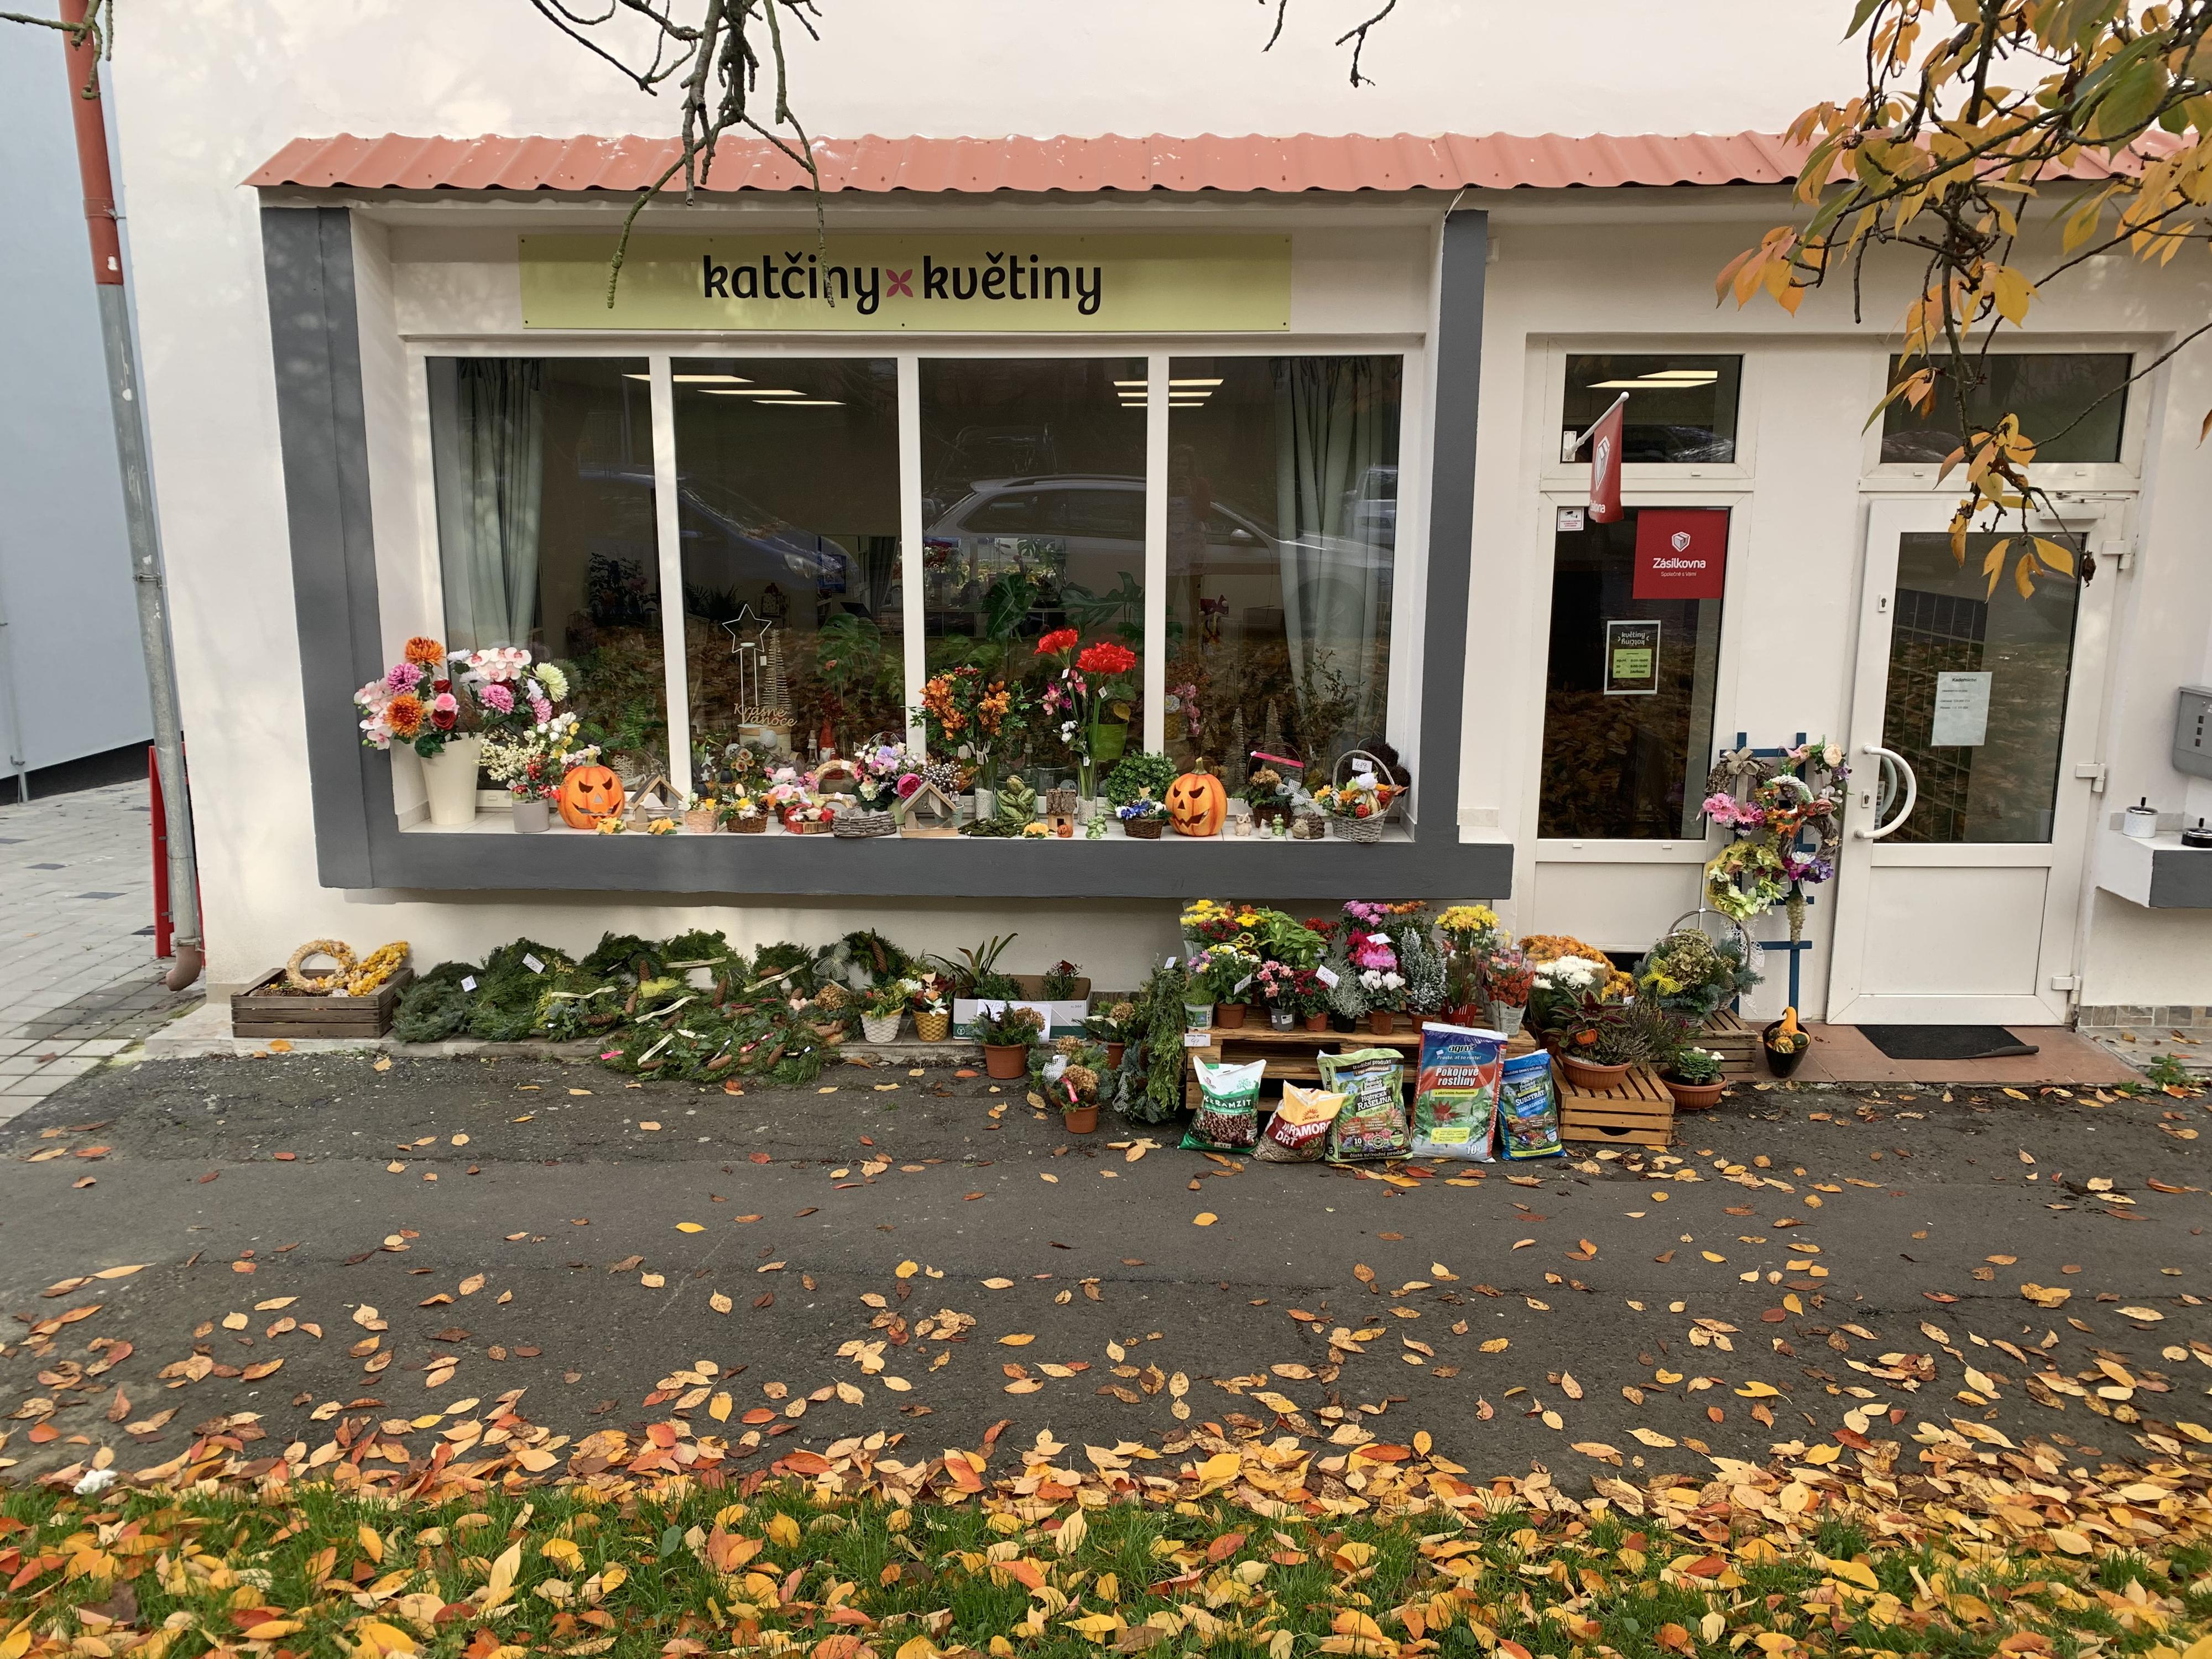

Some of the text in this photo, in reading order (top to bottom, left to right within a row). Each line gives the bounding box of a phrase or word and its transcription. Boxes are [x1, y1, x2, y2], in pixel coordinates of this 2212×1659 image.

[703, 251, 1102, 315] katčiny květiny
[1652, 557, 1707, 568] Zásilkovna
[1448, 1045, 1472, 1053] agro
[1353, 1061, 1373, 1070] tradiční
[1436, 1066, 1479, 1078] Pokojové
[1437, 1077, 1476, 1087] rostliny
[1203, 1094, 1252, 1108] KERAMZIT
[1358, 1095, 1392, 1111] RAŠELINA
[1365, 1105, 1387, 1116] zahradní
[1467, 1145, 1477, 1155] 10
